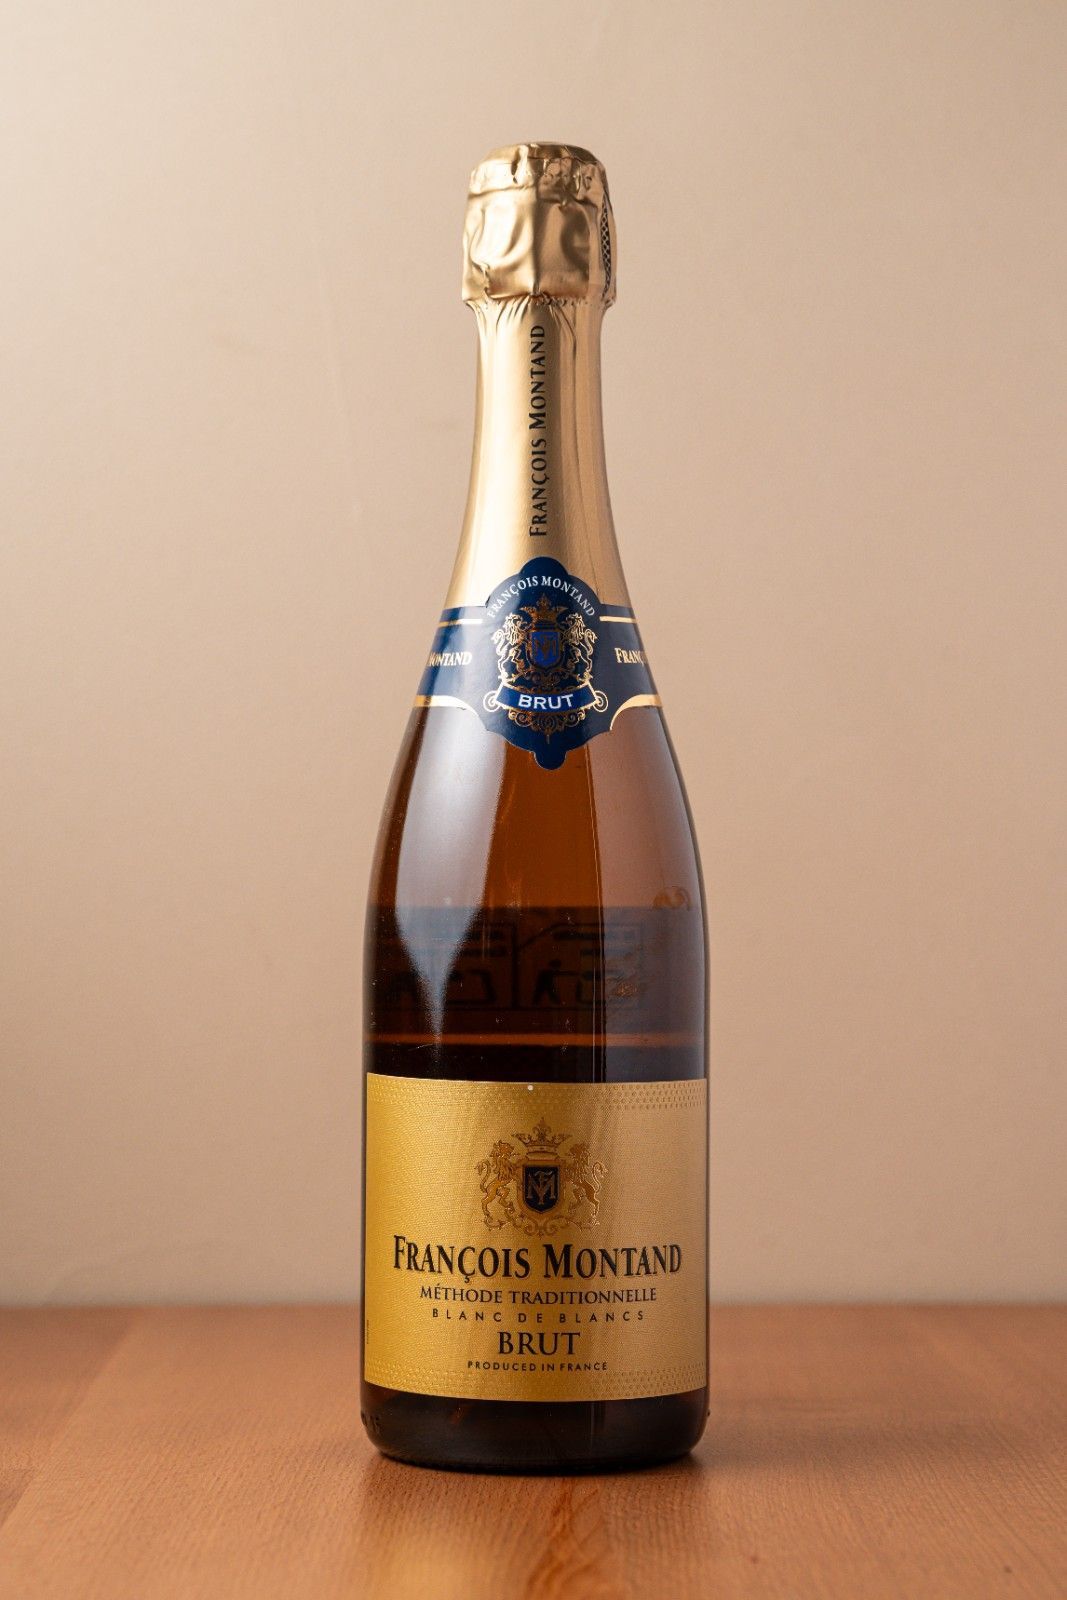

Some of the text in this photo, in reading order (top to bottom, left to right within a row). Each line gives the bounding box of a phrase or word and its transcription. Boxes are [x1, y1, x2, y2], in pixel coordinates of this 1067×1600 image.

[528, 325, 549, 537] FRANÇOIS MONTAND
[487, 575, 596, 619] FRANÇOIS MONTAND
[517, 693, 574, 710] BRUT
[392, 1235, 683, 1283] FRANÇOIS MONTAND
[420, 1283, 658, 1305] MÉTHODE TRADITIONNELLE
[432, 1308, 645, 1324] BLANC DE BLANCS
[497, 1331, 581, 1356] BRUT
[467, 1361, 608, 1372] PRODUCED IN FRANCE
